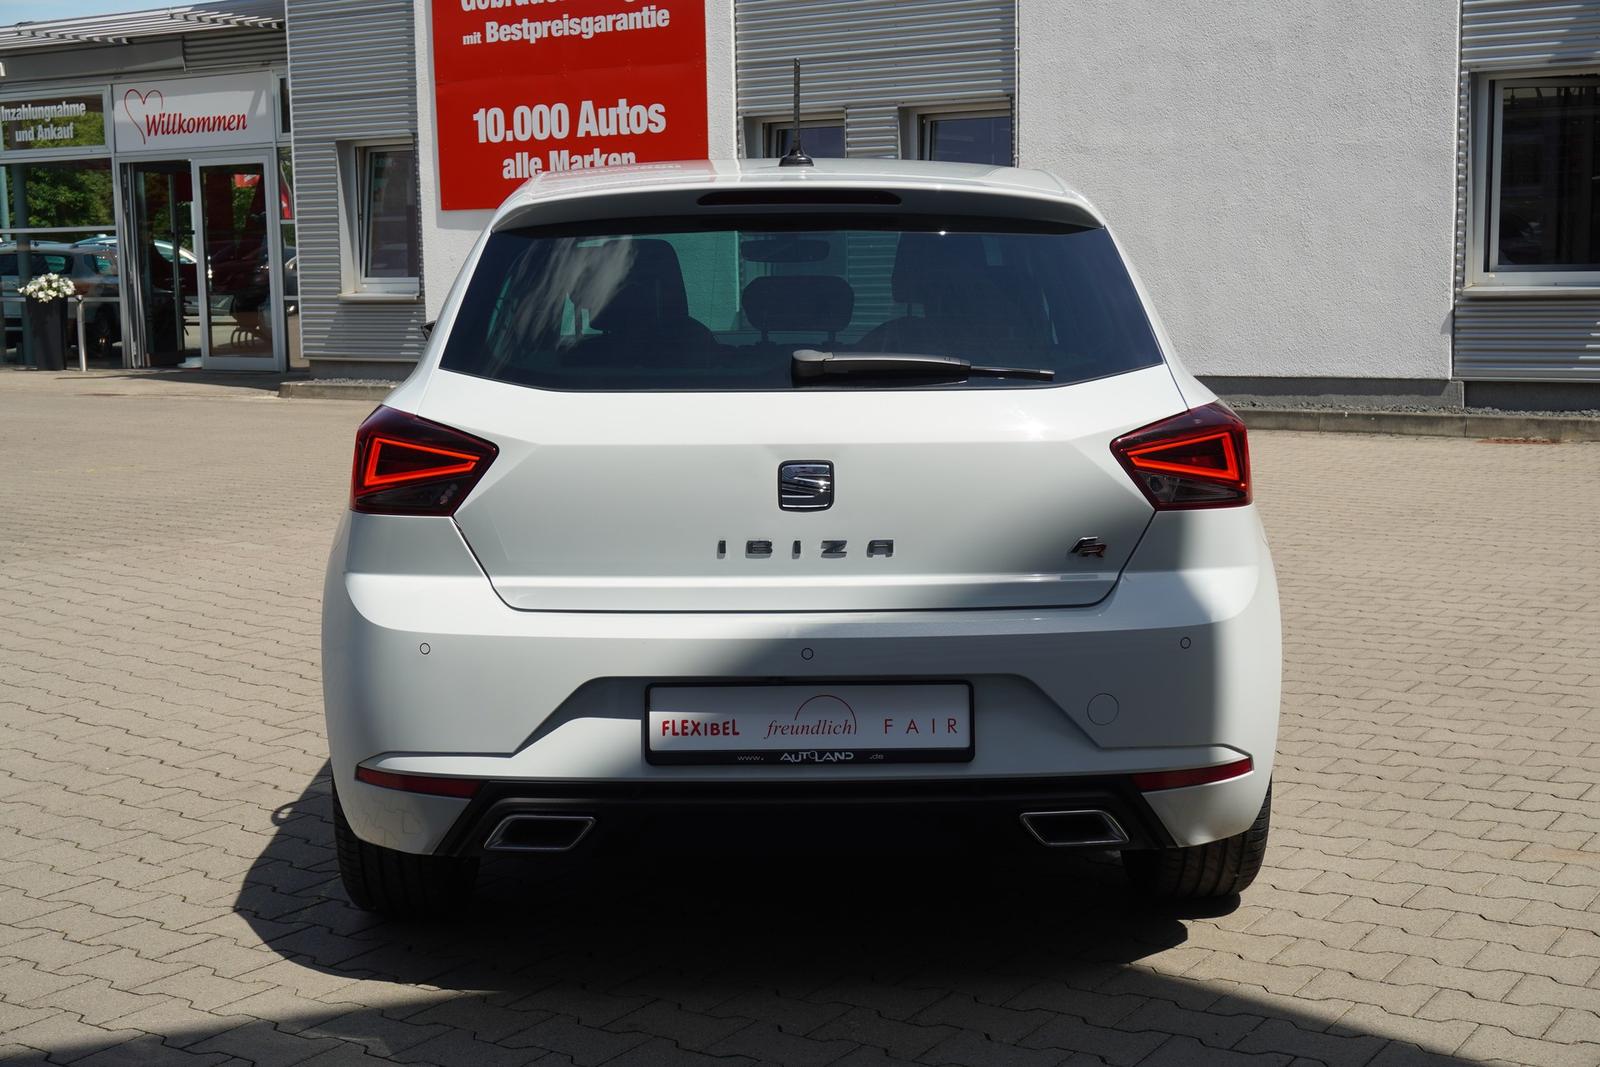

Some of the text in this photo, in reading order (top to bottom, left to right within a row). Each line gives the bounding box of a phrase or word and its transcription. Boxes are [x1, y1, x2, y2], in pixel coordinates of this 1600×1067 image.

[462, 31, 482, 45] mit
[485, 5, 671, 44] Bestpreisgarantie
[1, 101, 87, 122] Inzahlungnahme
[472, 98, 667, 143] 10.000 Autos
[15, 122, 74, 142] und Ankauf
[145, 112, 248, 137] Willkommen
[502, 152, 543, 179] alle
[716, 539, 895, 559] IBIZA
[661, 718, 958, 740] FLEXIBEL freundlich FAIR
[780, 750, 855, 763] AUTOLAND
